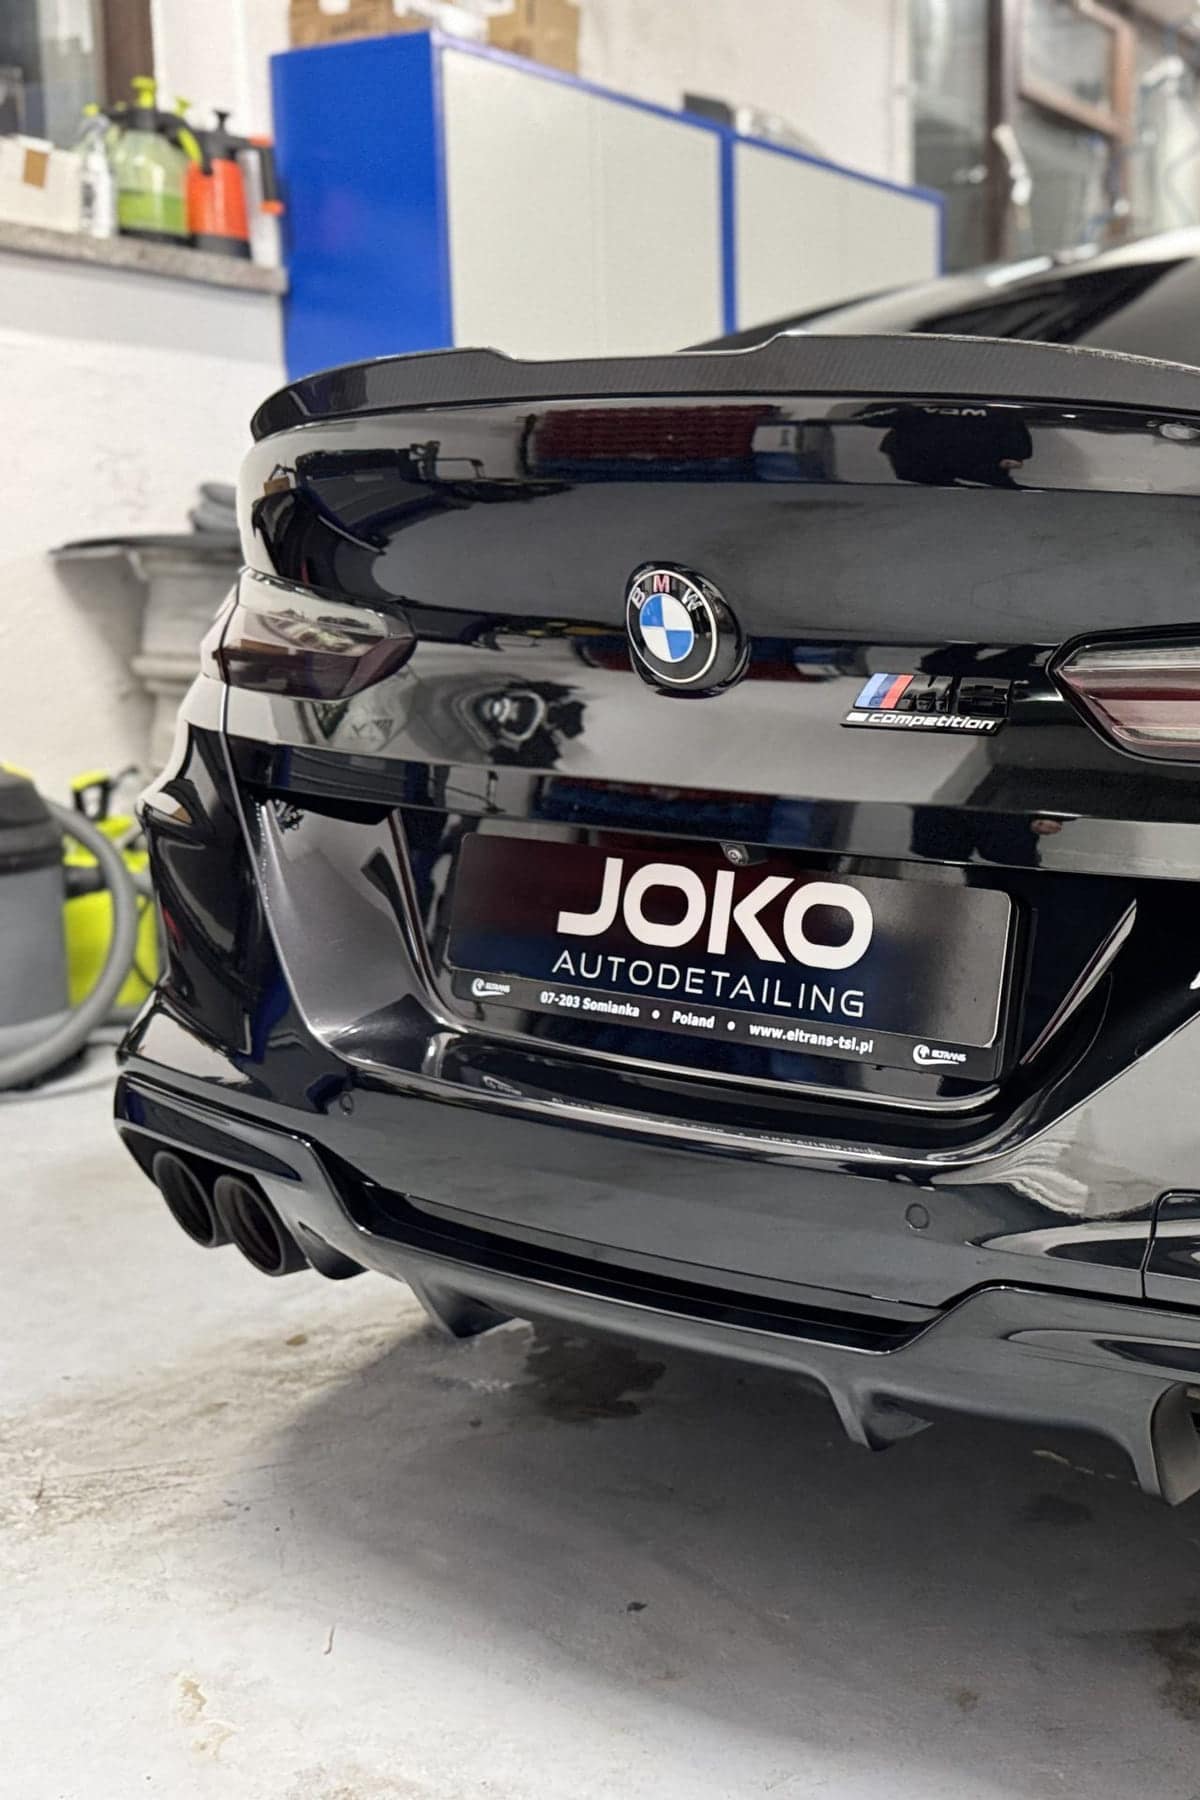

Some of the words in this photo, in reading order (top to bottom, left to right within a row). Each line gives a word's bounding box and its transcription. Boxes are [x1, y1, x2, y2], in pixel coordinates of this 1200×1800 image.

[631, 574, 703, 613] BMW
[868, 712, 996, 731] competition
[557, 857, 873, 970] JOKO
[552, 950, 865, 1018] AUTODETAILING
[540, 990, 580, 1008] 07-203
[582, 997, 640, 1018] Somianka
[672, 1010, 715, 1029] Poland
[749, 1023, 874, 1053] www.eltrans-tsl.pl
